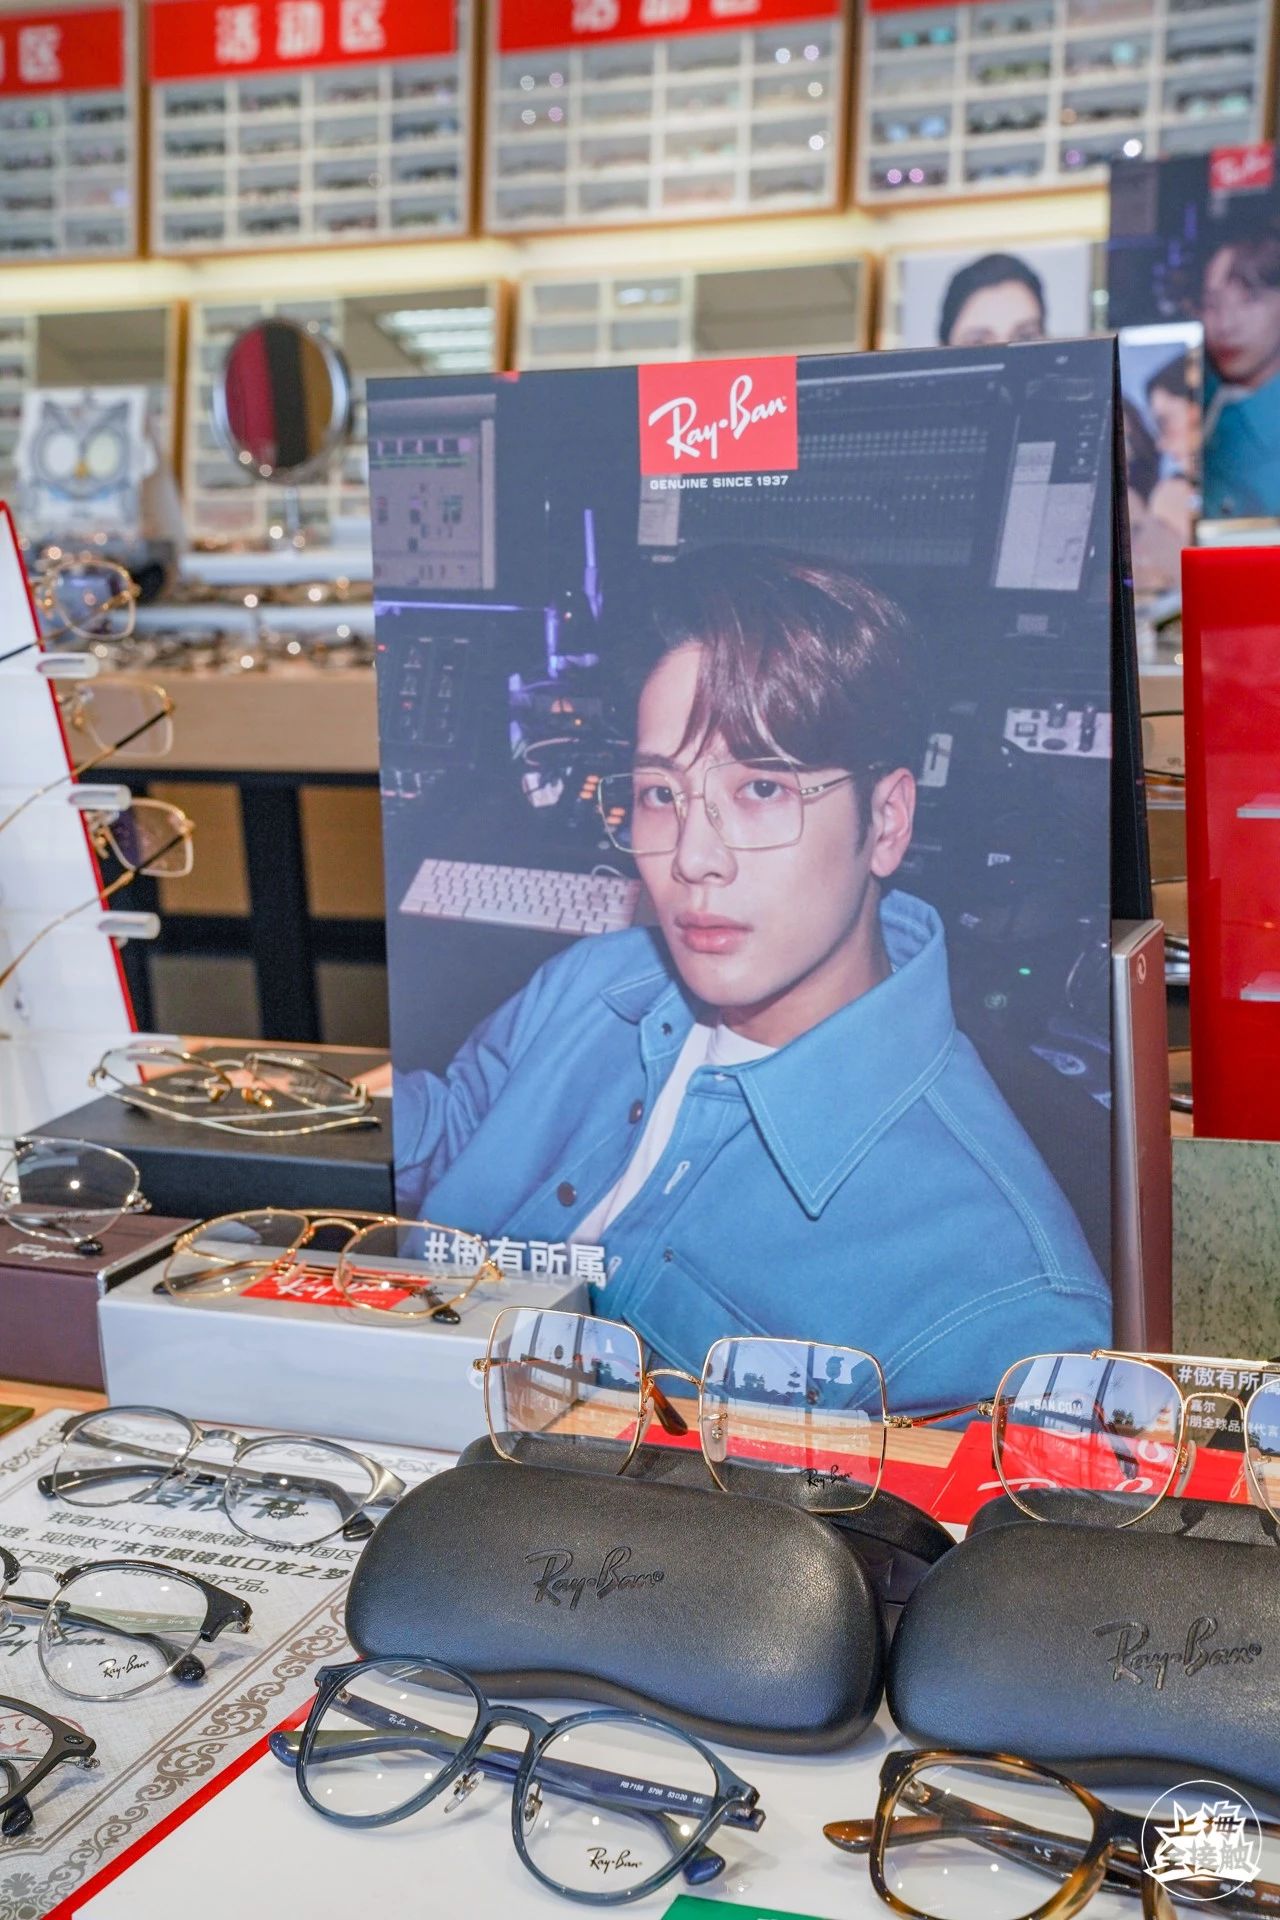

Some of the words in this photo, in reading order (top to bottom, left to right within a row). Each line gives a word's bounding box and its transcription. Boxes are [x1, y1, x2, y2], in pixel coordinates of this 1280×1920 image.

[650, 478, 708, 490] GENUINE
[712, 475, 753, 488] SINCE
[756, 474, 790, 487] 1937
